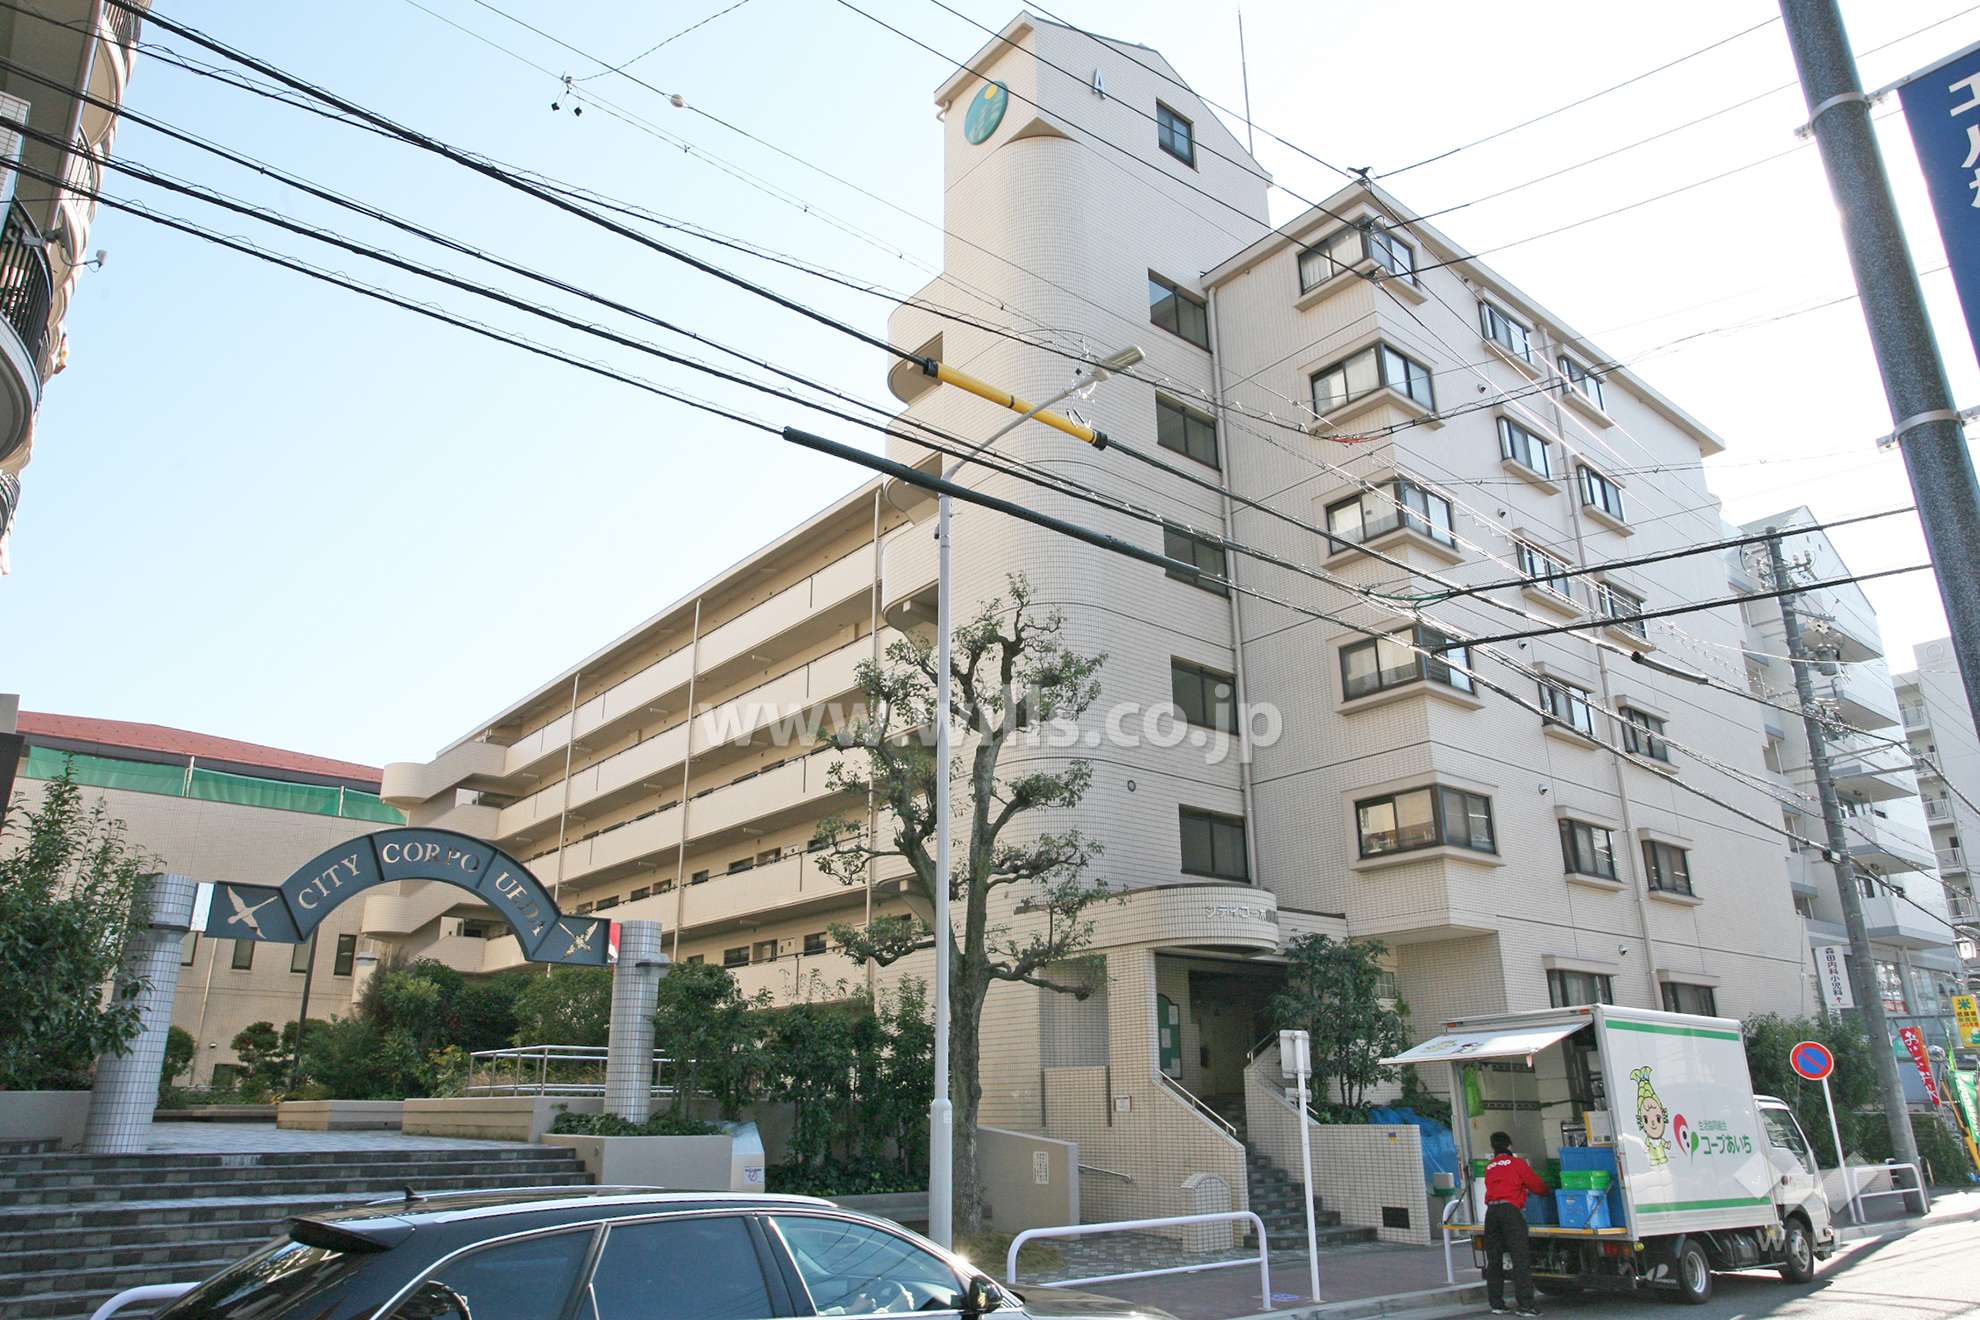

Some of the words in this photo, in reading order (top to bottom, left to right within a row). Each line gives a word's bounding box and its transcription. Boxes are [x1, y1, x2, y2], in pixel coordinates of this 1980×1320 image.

[299, 854, 360, 910] CITY
[382, 842, 481, 873] CORPO
[1700, 1134, 1752, 1155] コープあいち
